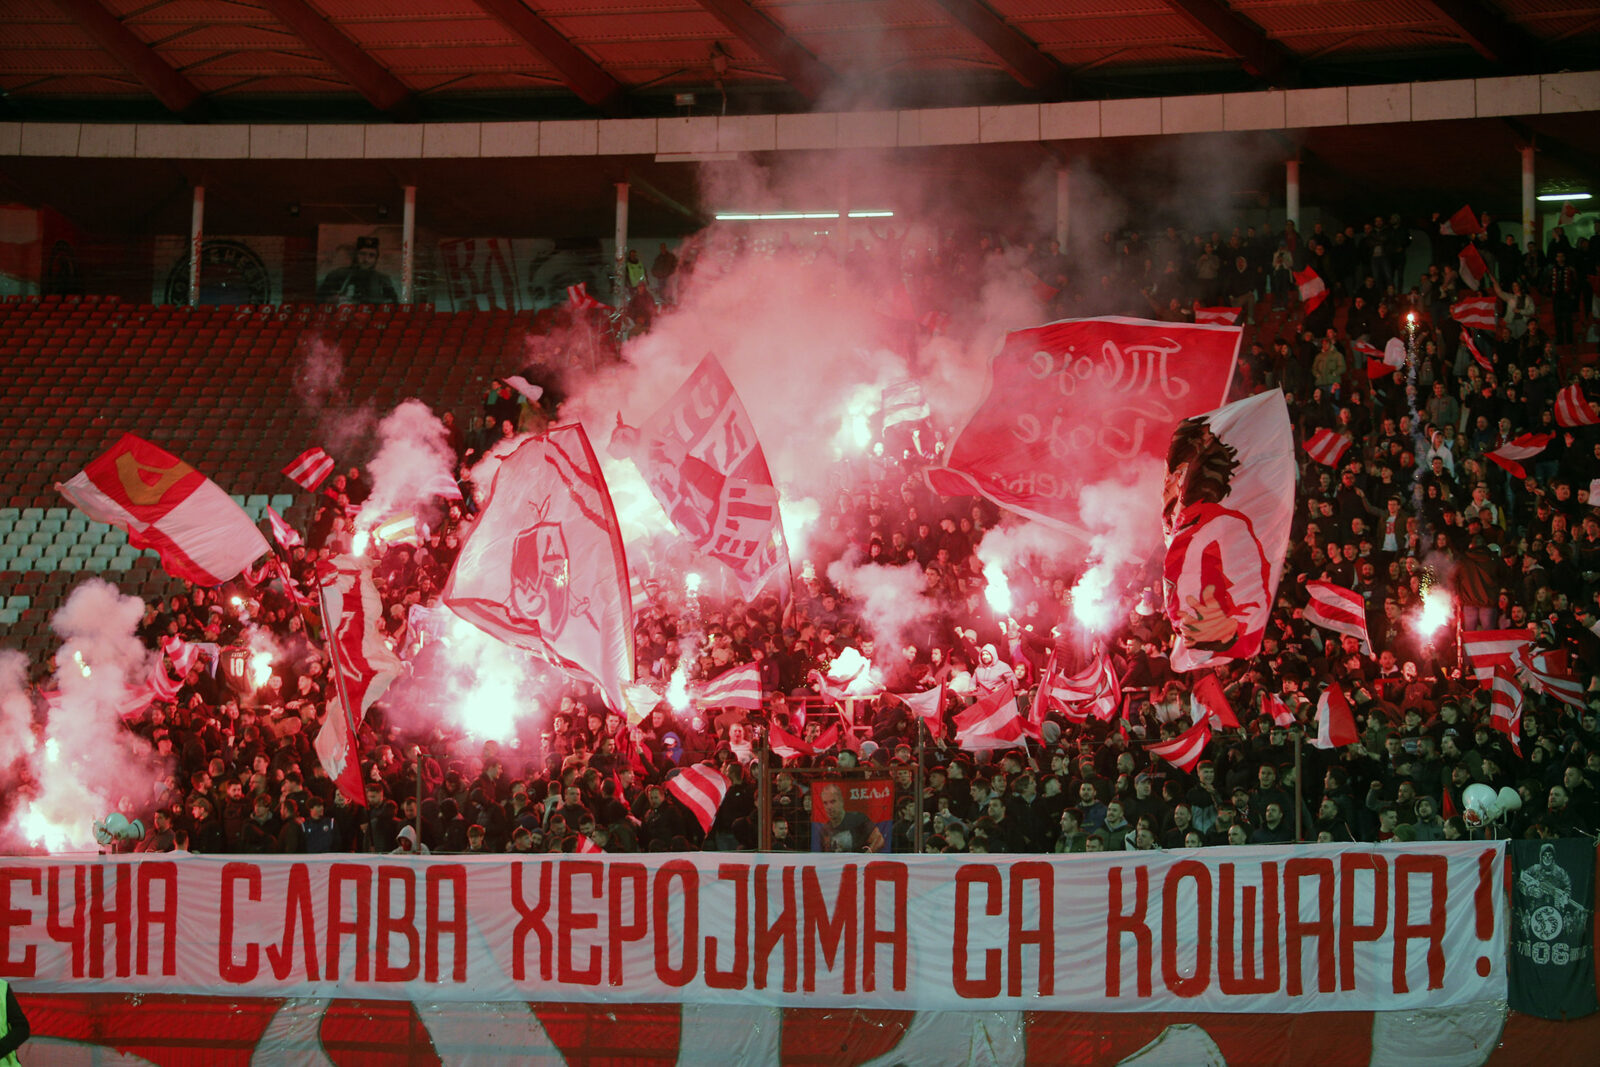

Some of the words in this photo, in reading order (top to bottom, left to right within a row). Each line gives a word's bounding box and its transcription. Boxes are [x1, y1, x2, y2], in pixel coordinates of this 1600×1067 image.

[231, 658, 244, 677] 10
[0, 861, 178, 978] ЕЧНА
[218, 862, 468, 984] СЛАВА
[510, 860, 909, 994] ХЕРОЈИМА
[952, 861, 1055, 999] СА
